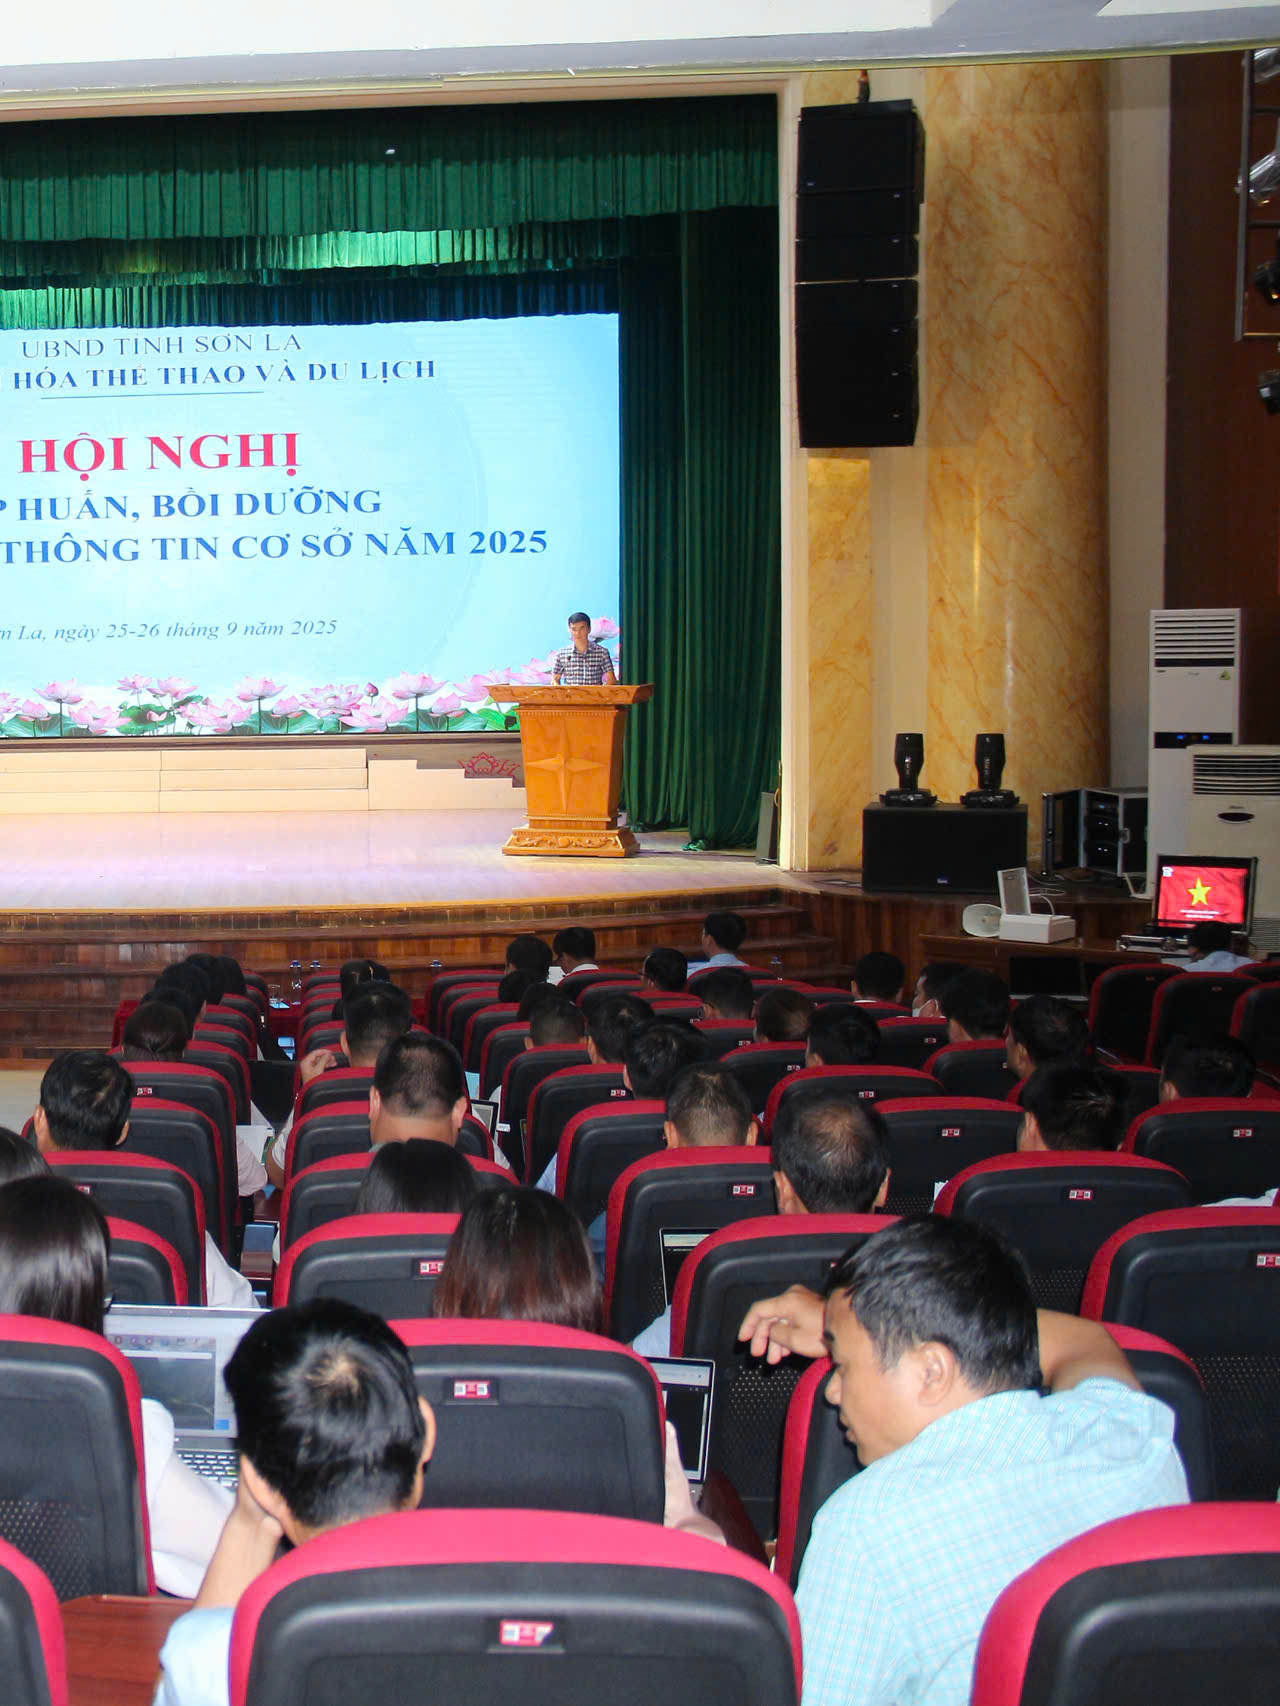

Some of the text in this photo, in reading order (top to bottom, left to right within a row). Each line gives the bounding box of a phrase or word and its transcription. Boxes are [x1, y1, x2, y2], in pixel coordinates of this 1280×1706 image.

[21, 338, 105, 359] UBND
[195, 333, 253, 353] SƠN
[265, 333, 302, 351] LA
[13, 366, 78, 390] HÓA
[86, 363, 148, 387] THỂ
[157, 365, 246, 385] THAO
[255, 359, 297, 383] VÀ
[308, 362, 349, 382] DU
[361, 360, 436, 384] LỊCH
[17, 432, 302, 482] HỘI NGHỊ
[15, 489, 140, 523] HUẤN,
[151, 487, 220, 518] BỒI
[234, 486, 382, 517] DƯỠNG
[151, 536, 220, 561] TIN
[231, 532, 291, 560] CƠ
[301, 527, 354, 559] SỞ
[364, 526, 457, 557] NĂM
[468, 529, 549, 555] 2025
[19, 625, 47, 643] La,
[54, 624, 100, 643] ngày
[105, 623, 161, 639] 25-26
[166, 622, 221, 641] tháng
[226, 621, 239, 637] 9
[243, 620, 284, 637] năm
[291, 619, 338, 636] 2025
